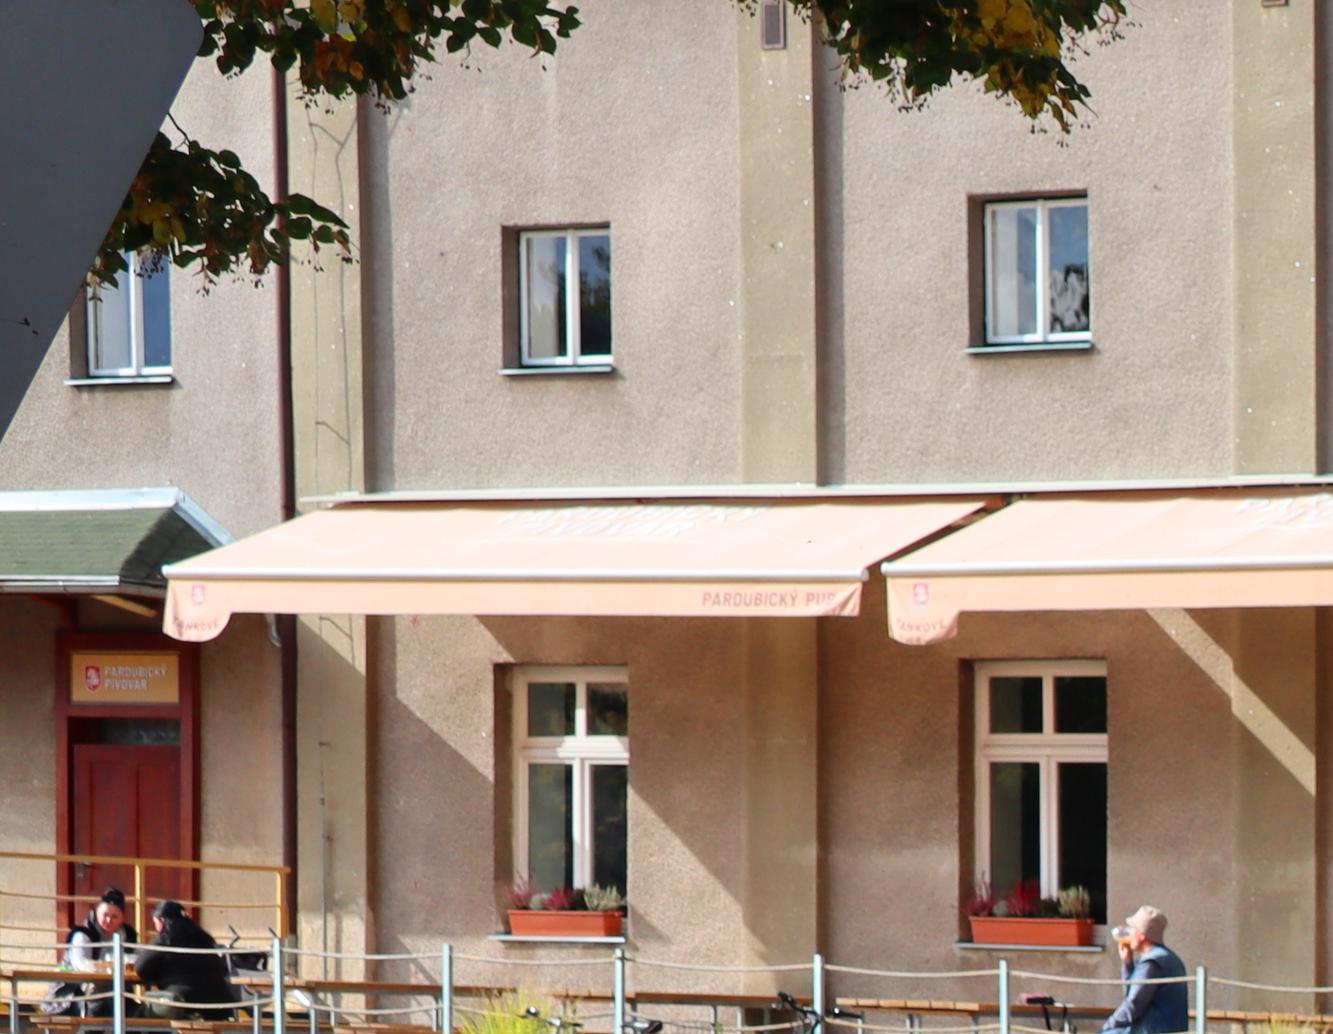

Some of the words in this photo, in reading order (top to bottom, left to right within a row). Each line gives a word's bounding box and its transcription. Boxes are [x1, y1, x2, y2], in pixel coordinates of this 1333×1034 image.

[702, 588, 799, 608] PARDUBICKÝ
[104, 664, 168, 678] PARDUBICKÝ
[104, 679, 148, 690] PIVOVAR
